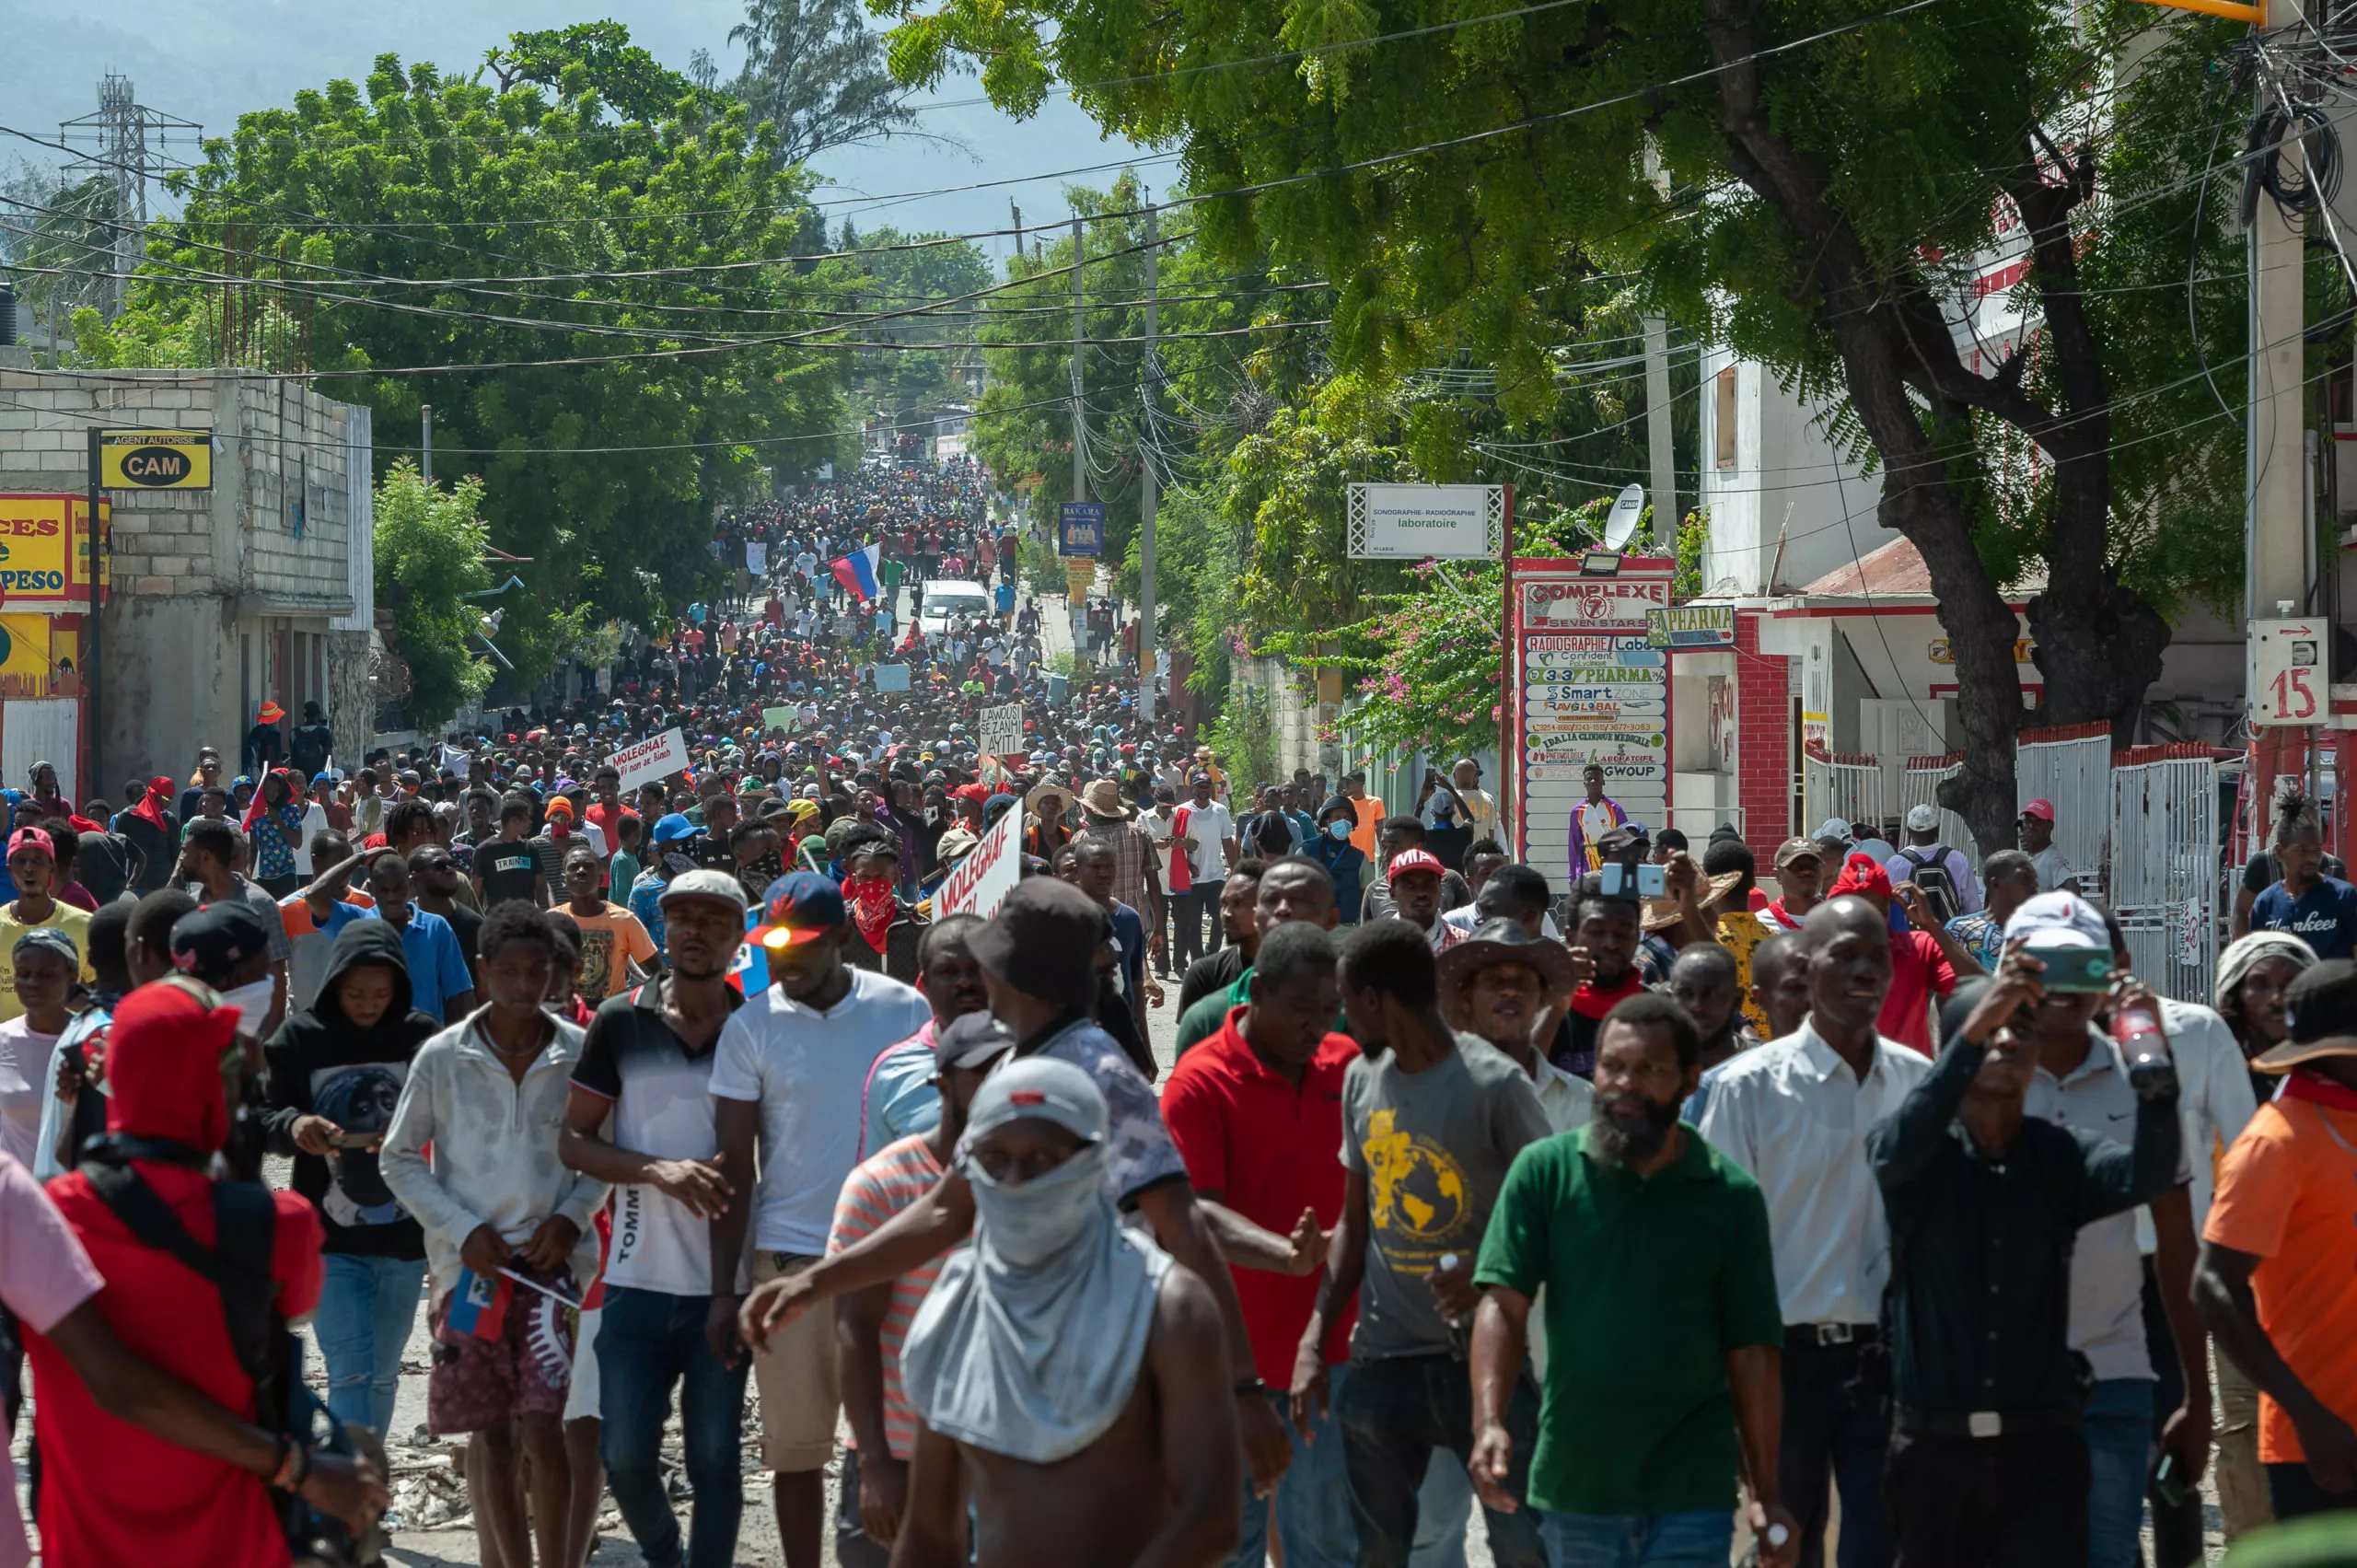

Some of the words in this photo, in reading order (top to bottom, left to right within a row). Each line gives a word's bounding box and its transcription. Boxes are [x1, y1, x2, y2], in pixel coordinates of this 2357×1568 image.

[115, 436, 147, 445] AGENT
[148, 436, 196, 445] AUTORISE
[127, 457, 180, 476] CAM
[1398, 518, 1457, 528] laboratoire
[1, 570, 64, 590] PESO
[1527, 584, 1664, 604] COMPLEXE
[1549, 619, 1596, 628] SEVEN
[1599, 619, 1647, 628] STARS
[1666, 608, 1733, 632] PHARMA
[1562, 652, 1614, 660] Confident
[1585, 668, 1653, 683] PHARMA
[2270, 668, 2316, 719] 15
[981, 707, 1020, 723] LAWOUSI
[981, 723, 992, 736] SE
[992, 720, 1021, 736] ZANMI
[987, 735, 1017, 754] AYITI
[1542, 733, 1578, 749] IDALIA
[1578, 733, 1613, 741] CLINIQUE
[1614, 733, 1651, 749] MEDICALE
[612, 734, 668, 768] MOLEGHAF
[1604, 765, 1655, 777] GWOUP
[940, 814, 1010, 920] MOLEGHAF
[1395, 848, 1434, 868] MIA
[617, 1188, 640, 1265] TOMM
